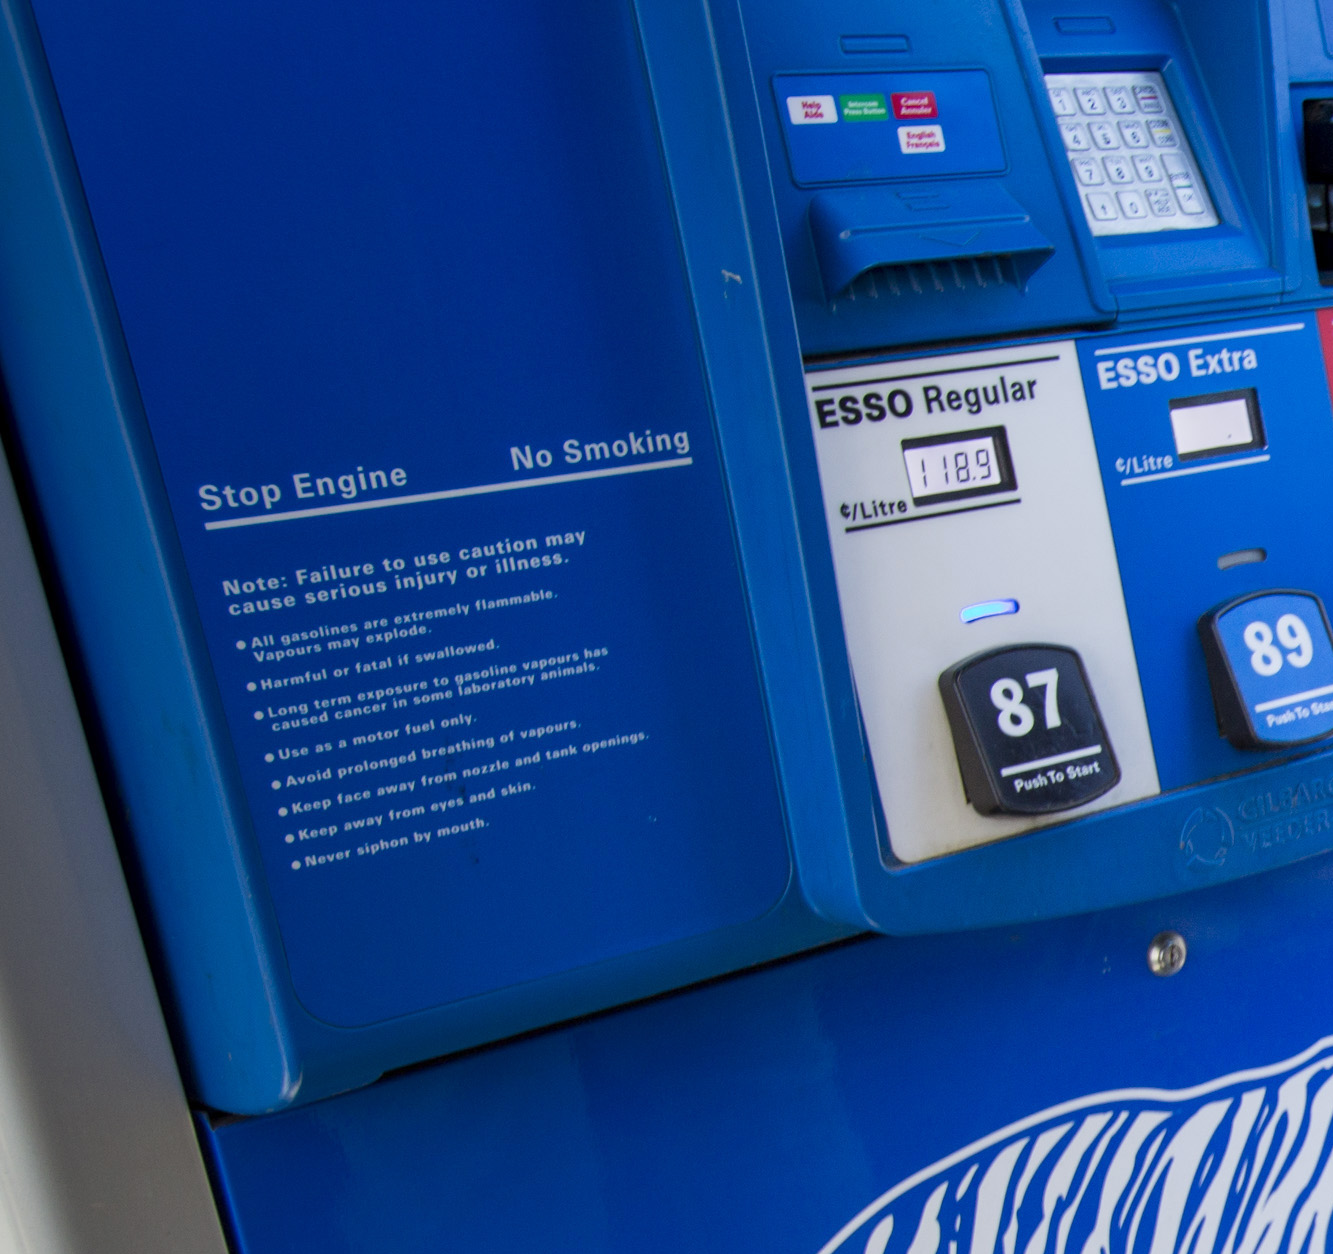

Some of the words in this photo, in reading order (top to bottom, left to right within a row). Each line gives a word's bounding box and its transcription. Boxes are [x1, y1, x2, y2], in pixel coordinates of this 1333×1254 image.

[801, 100, 822, 111] Help
[804, 110, 824, 119] Aide
[900, 97, 929, 106] Cancel
[906, 131, 936, 141] English
[1096, 352, 1180, 390] ESSO
[1188, 346, 1258, 378] Extra
[815, 389, 913, 429] ESSO
[922, 376, 1037, 415] Regular
[510, 445, 552, 470] No
[563, 429, 689, 463] Smoking
[920, 448, 992, 489] 118.9
[198, 484, 281, 510] Stop
[292, 466, 407, 499] Engine
[221, 576, 288, 597] Note:
[294, 562, 375, 586] Failure
[381, 557, 406, 572] to
[413, 551, 451, 568] use
[458, 537, 538, 561] caution
[544, 530, 586, 548] may
[227, 594, 296, 616] cause
[303, 580, 388, 605] serious
[393, 569, 457, 591] injury
[465, 564, 488, 579] or
[494, 552, 569, 574] illness.
[250, 634, 275, 649] All
[279, 622, 358, 646] gasolines
[363, 617, 388, 630] are
[393, 602, 470, 625] extremely
[474, 588, 558, 611] flammable.
[252, 643, 322, 663] Vapours
[326, 636, 360, 651] may
[365, 624, 432, 644] explode.
[259, 668, 328, 691] Harmful
[332, 666, 350, 678] or
[354, 656, 393, 674] fatal
[397, 653, 409, 667] if
[414, 638, 500, 664] swallowed.
[1243, 613, 1313, 677] 89
[266, 703, 309, 719] Long
[312, 694, 352, 710] term
[356, 680, 428, 702] exposure
[432, 676, 450, 688] to
[453, 663, 517, 687] gasoline
[521, 652, 580, 671] vapours
[582, 647, 609, 660] has
[271, 710, 329, 732] caused
[333, 702, 387, 720] cancer
[392, 697, 408, 709] in
[412, 689, 453, 705] some
[456, 674, 535, 698] laboratory
[540, 661, 601, 681] animals.
[990, 667, 1062, 737] 87
[277, 746, 309, 760] Use
[314, 742, 333, 753] as
[337, 739, 347, 749] a
[351, 728, 400, 746] motor
[404, 718, 436, 736] fuel
[439, 713, 479, 729] only.
[285, 767, 332, 788] Avoid
[336, 749, 417, 780] prolonged
[420, 736, 496, 760] breathing
[498, 729, 515, 744] of
[519, 719, 582, 739] vapours.
[290, 798, 332, 815] Keep
[336, 789, 371, 805] face
[376, 780, 416, 797] away
[420, 771, 457, 787] from
[461, 759, 510, 779] nozzle
[514, 750, 541, 767] and
[544, 744, 578, 761] tank
[581, 731, 651, 753] openings.
[1066, 761, 1100, 780] Start
[297, 824, 338, 841] Keep
[343, 814, 383, 832] away
[387, 805, 426, 822] from
[429, 797, 464, 813] eyes
[468, 787, 496, 804] and
[500, 781, 536, 797] skin.
[303, 849, 351, 868] Never
[356, 836, 409, 856] siphon
[412, 831, 432, 843] by
[436, 817, 490, 838] mouth.
